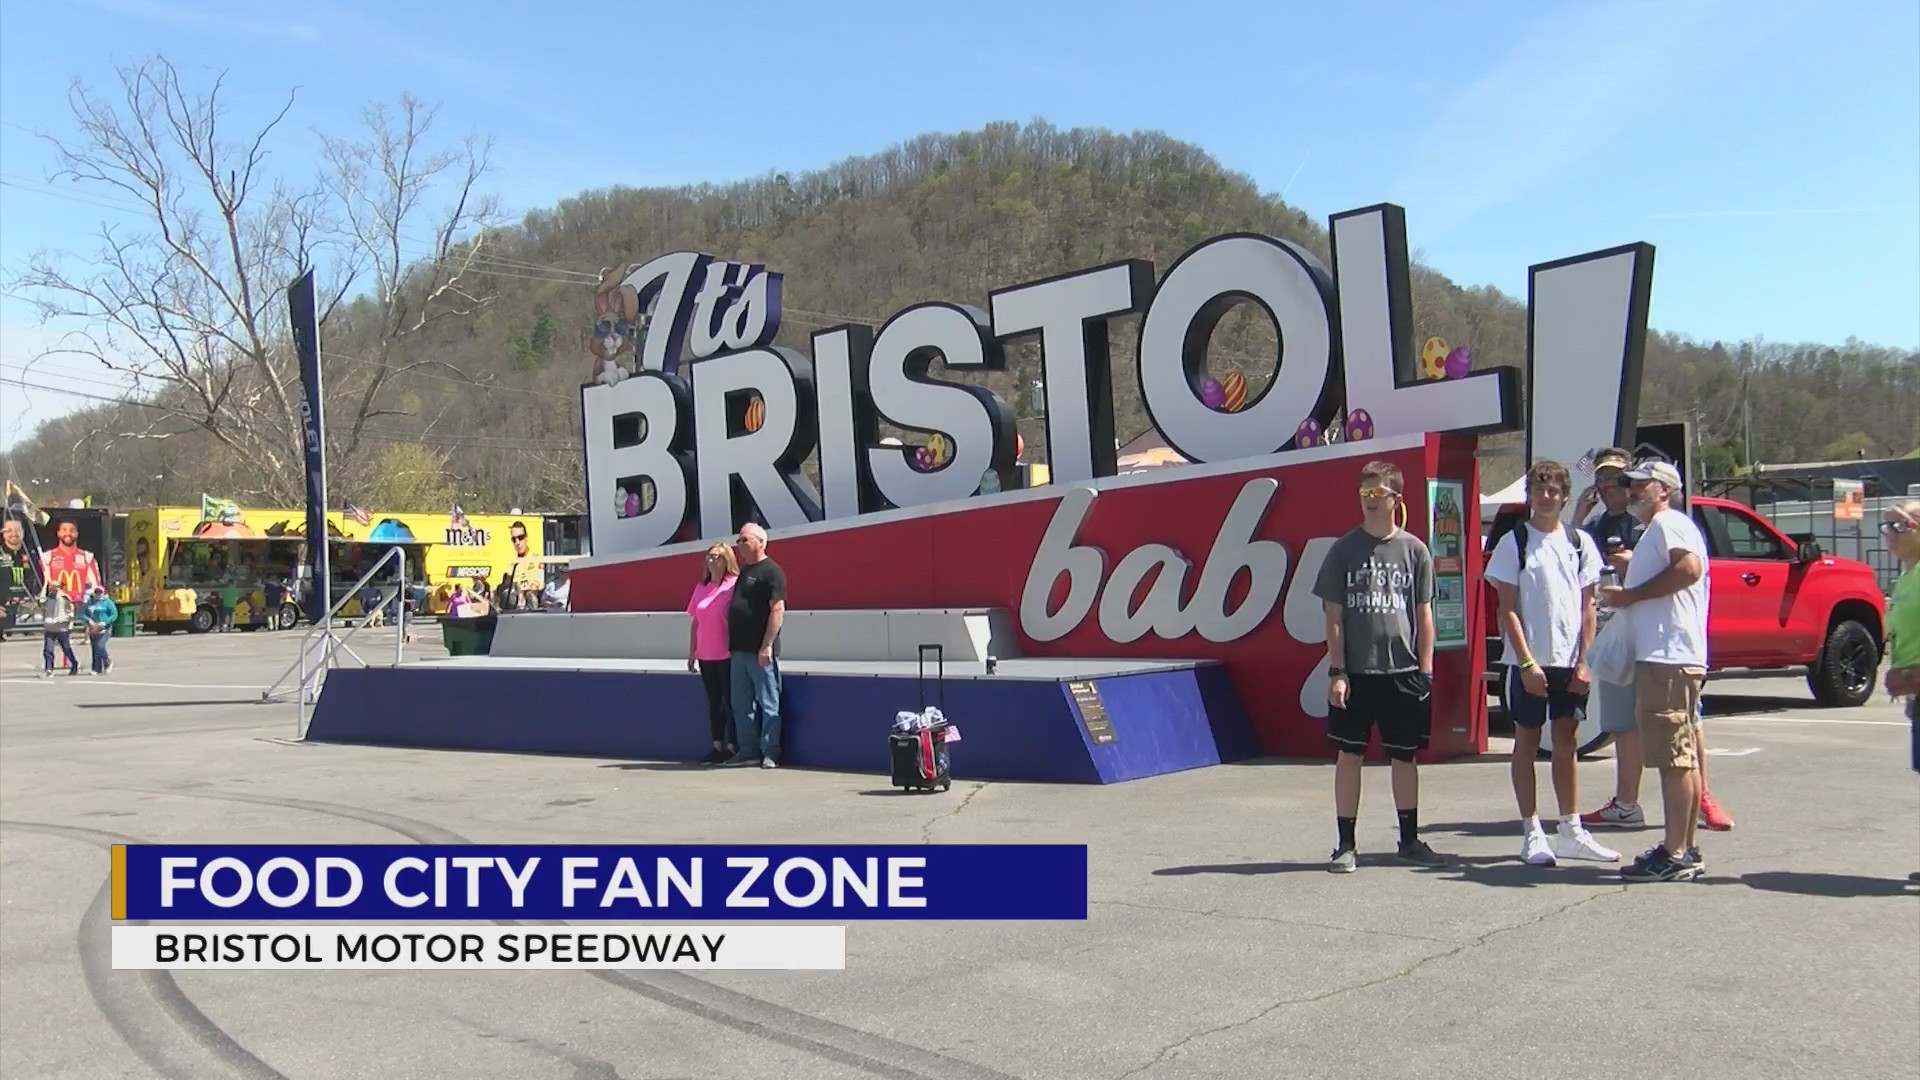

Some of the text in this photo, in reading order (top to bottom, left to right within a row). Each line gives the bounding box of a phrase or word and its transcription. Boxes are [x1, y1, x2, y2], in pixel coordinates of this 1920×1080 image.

[620, 251, 784, 373] It's
[1347, 569, 1412, 588] LET'S GO
